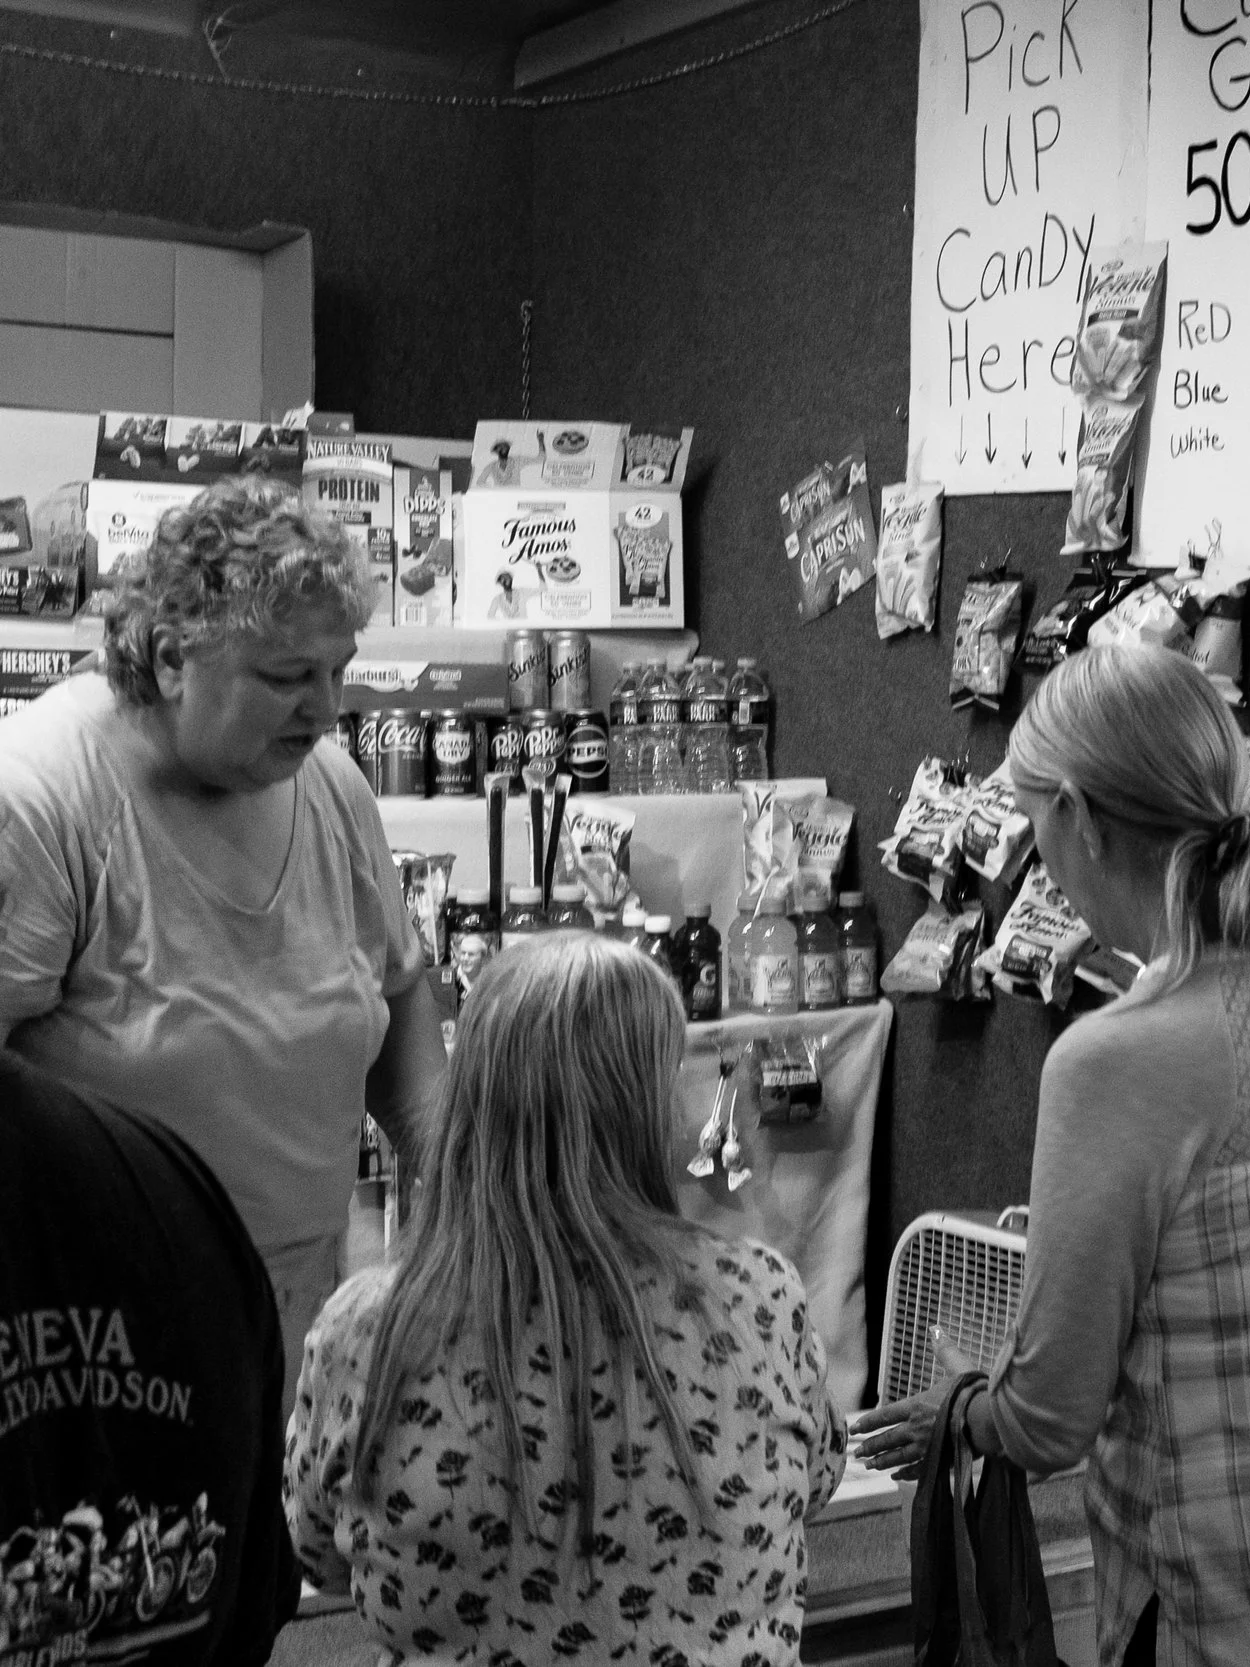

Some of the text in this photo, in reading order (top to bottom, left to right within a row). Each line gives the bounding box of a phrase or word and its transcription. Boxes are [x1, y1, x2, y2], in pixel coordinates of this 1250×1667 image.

[949, 318, 1075, 406] Here
[1173, 369, 1229, 409] Blue
[318, 478, 380, 503] PROTEIN
[634, 506, 652, 521] 42
[501, 517, 577, 549] Famous
[508, 536, 569, 565] Amos
[2, 650, 70, 675] HERSHEY'S
